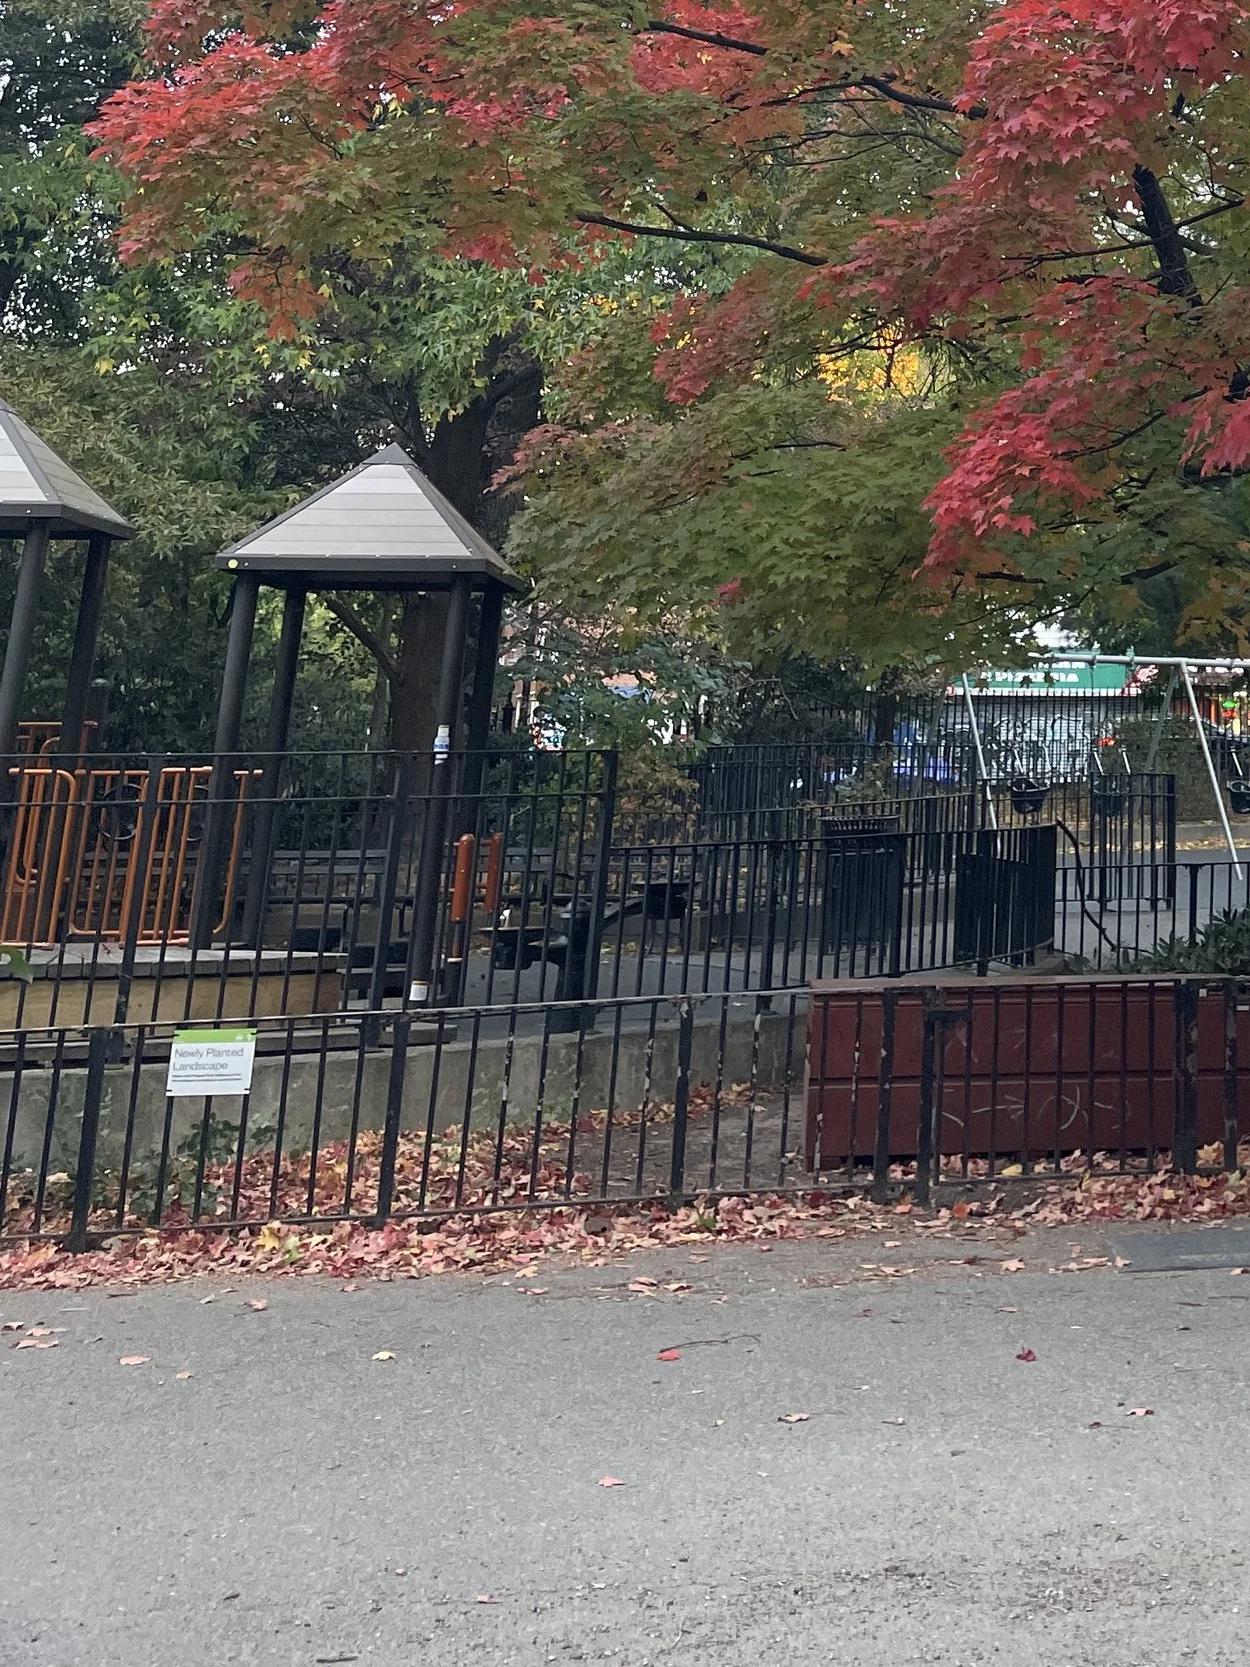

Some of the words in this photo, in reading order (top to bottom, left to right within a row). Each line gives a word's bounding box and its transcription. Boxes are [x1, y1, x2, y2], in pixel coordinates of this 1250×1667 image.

[174, 1048, 204, 1059] Newly
[206, 1047, 244, 1058] Planted
[172, 1062, 229, 1072] Landscape
